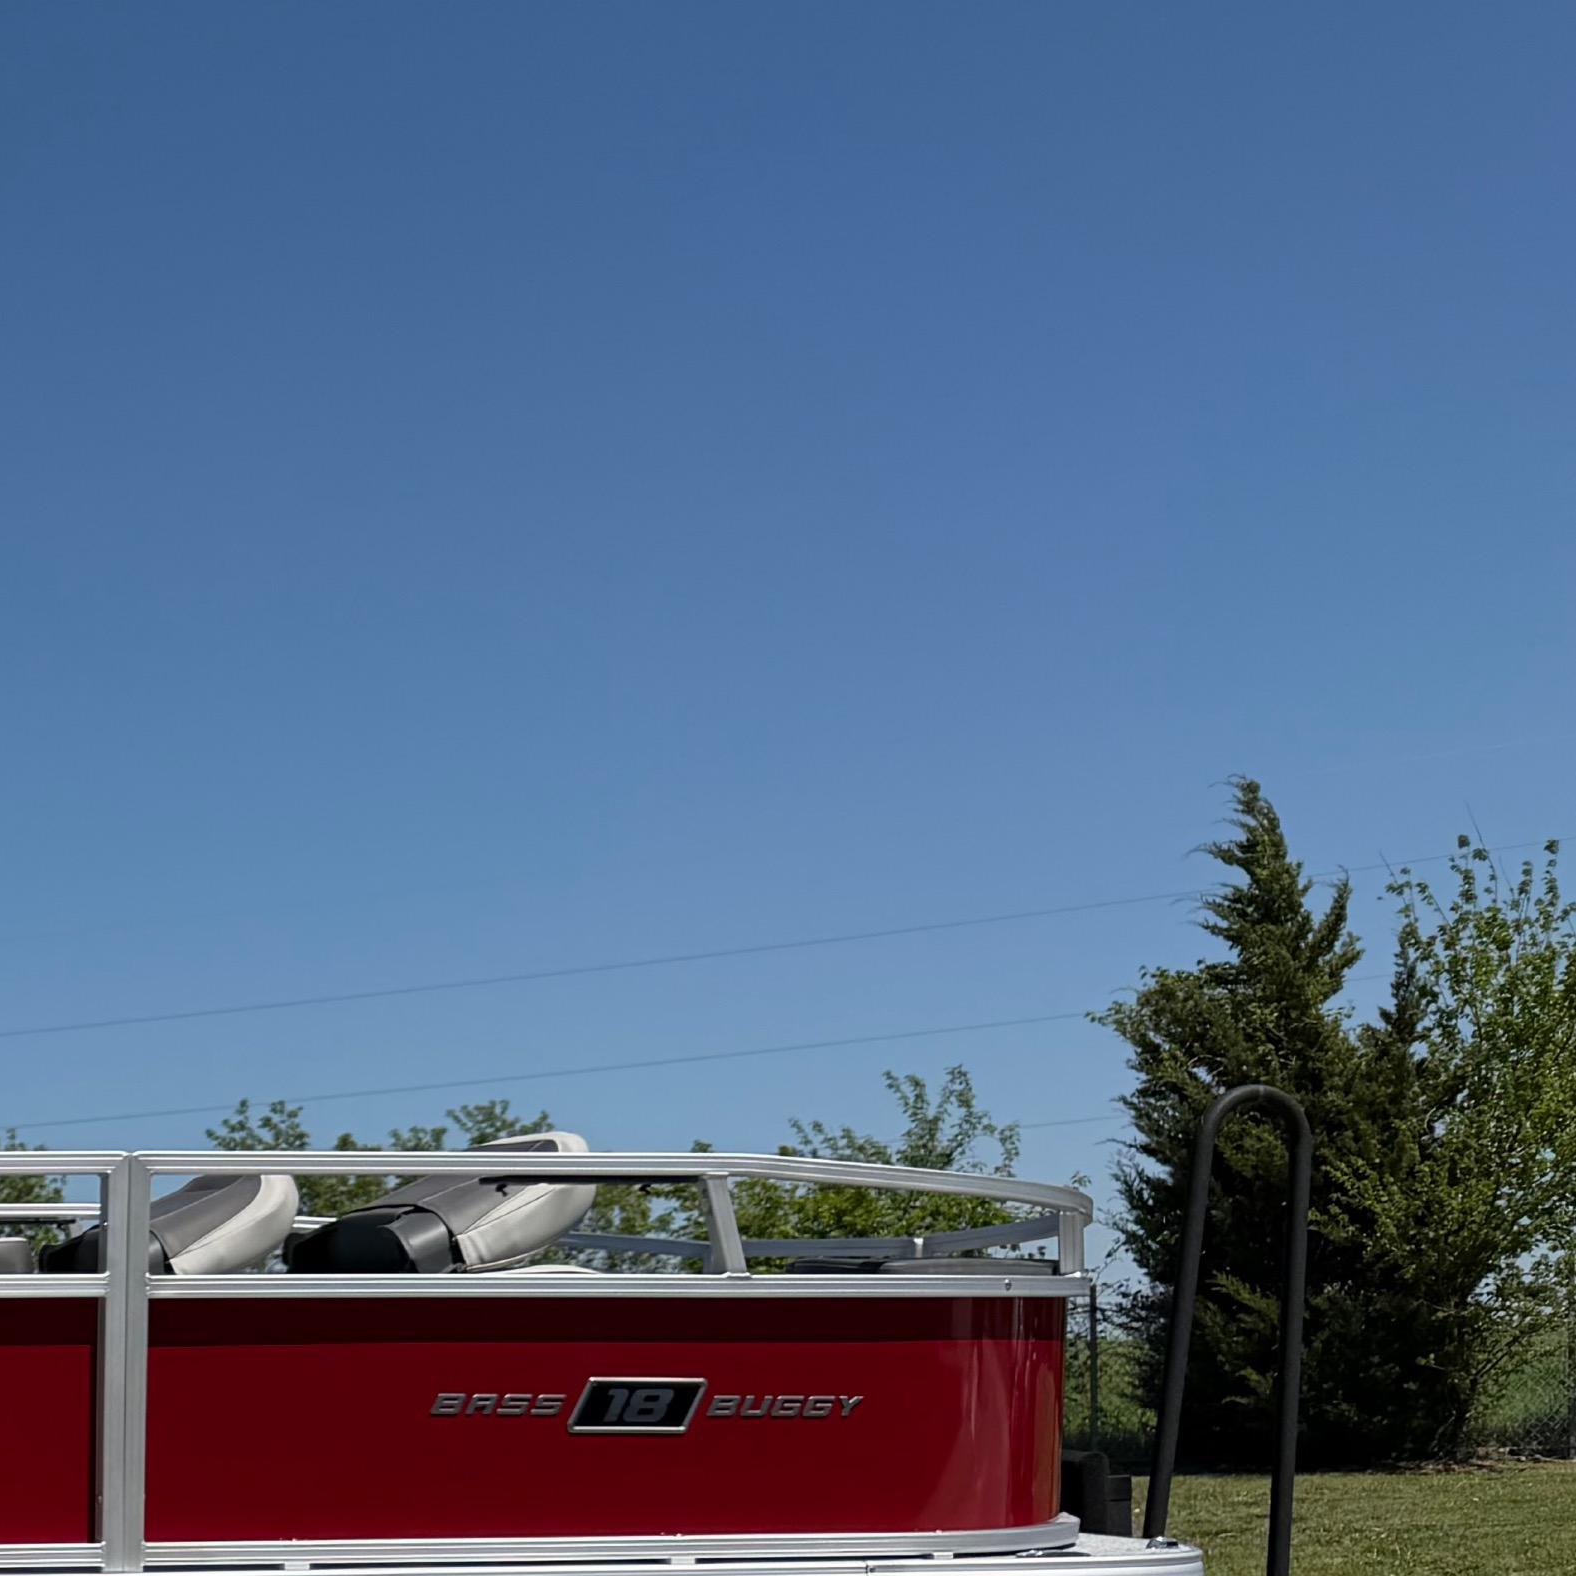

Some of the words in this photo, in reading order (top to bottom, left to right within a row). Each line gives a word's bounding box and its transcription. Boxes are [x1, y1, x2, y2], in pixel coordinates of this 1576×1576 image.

[430, 1393, 566, 1415] BASS
[602, 1388, 675, 1423] 18
[706, 1395, 864, 1417] BUGGY
